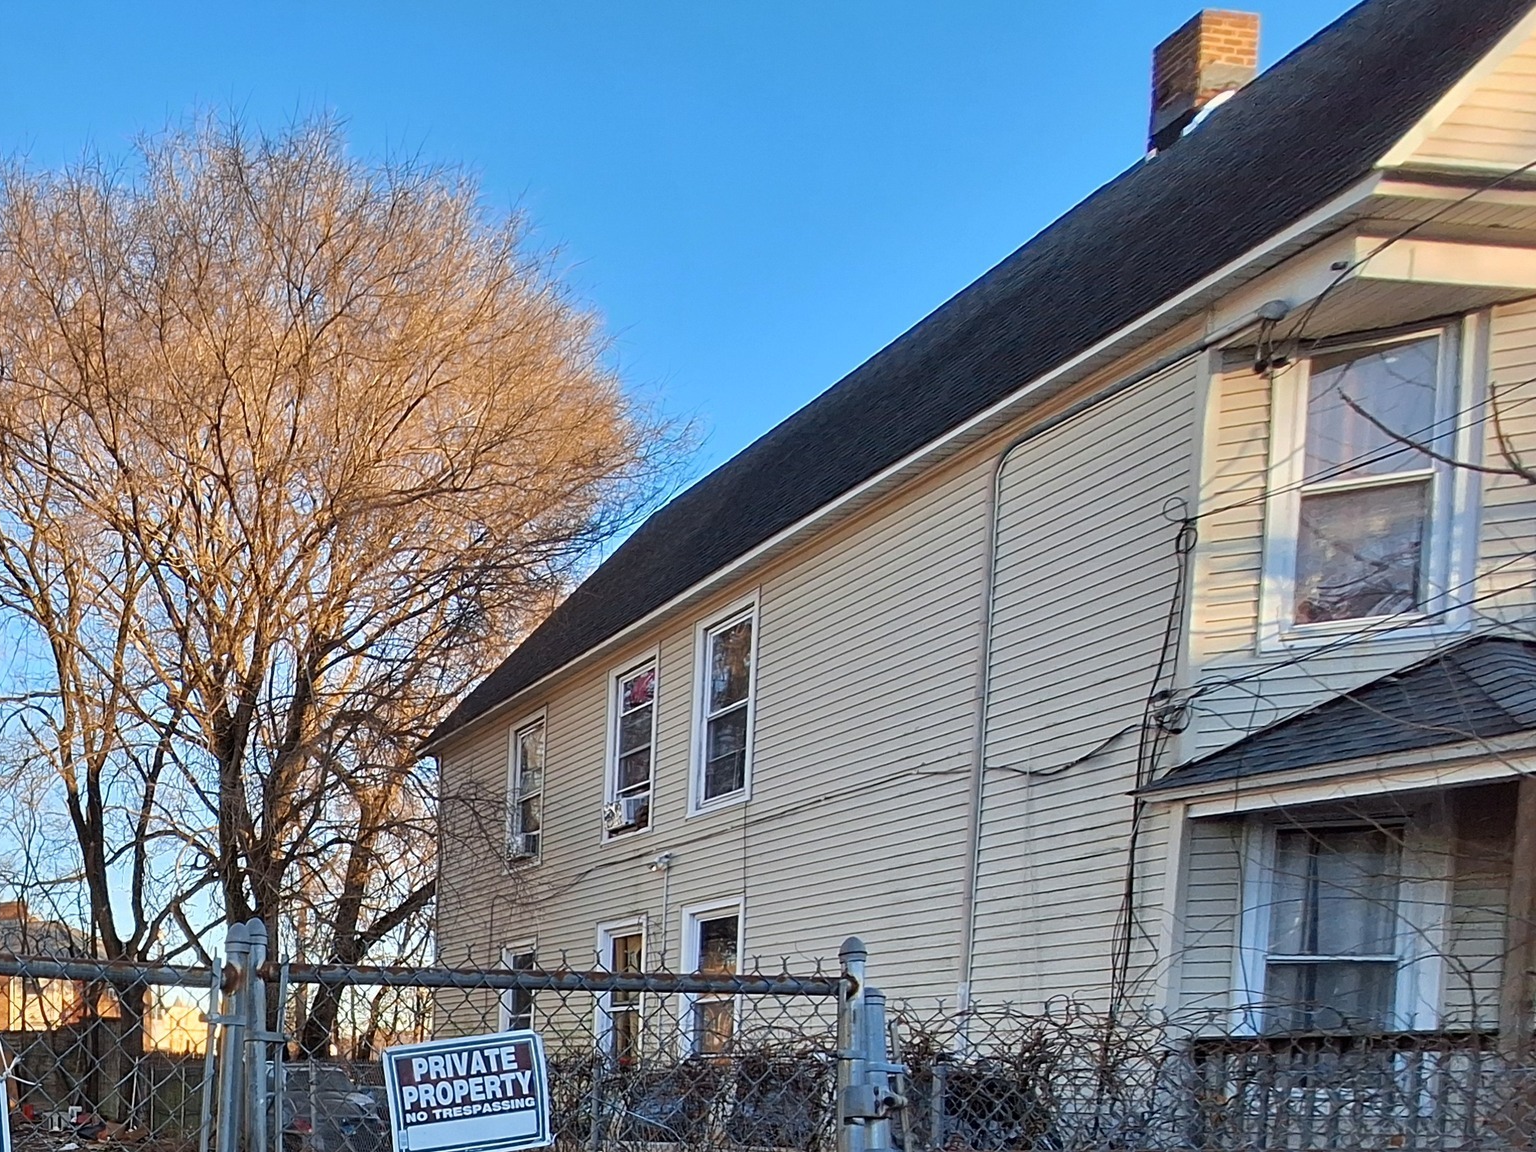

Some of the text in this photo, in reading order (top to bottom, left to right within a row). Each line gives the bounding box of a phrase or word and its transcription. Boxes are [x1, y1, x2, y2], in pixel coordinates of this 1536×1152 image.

[412, 1046, 518, 1082] PRIVATE
[402, 1070, 532, 1110] PROPERTY
[406, 1097, 536, 1124] NO TRESPASSING
